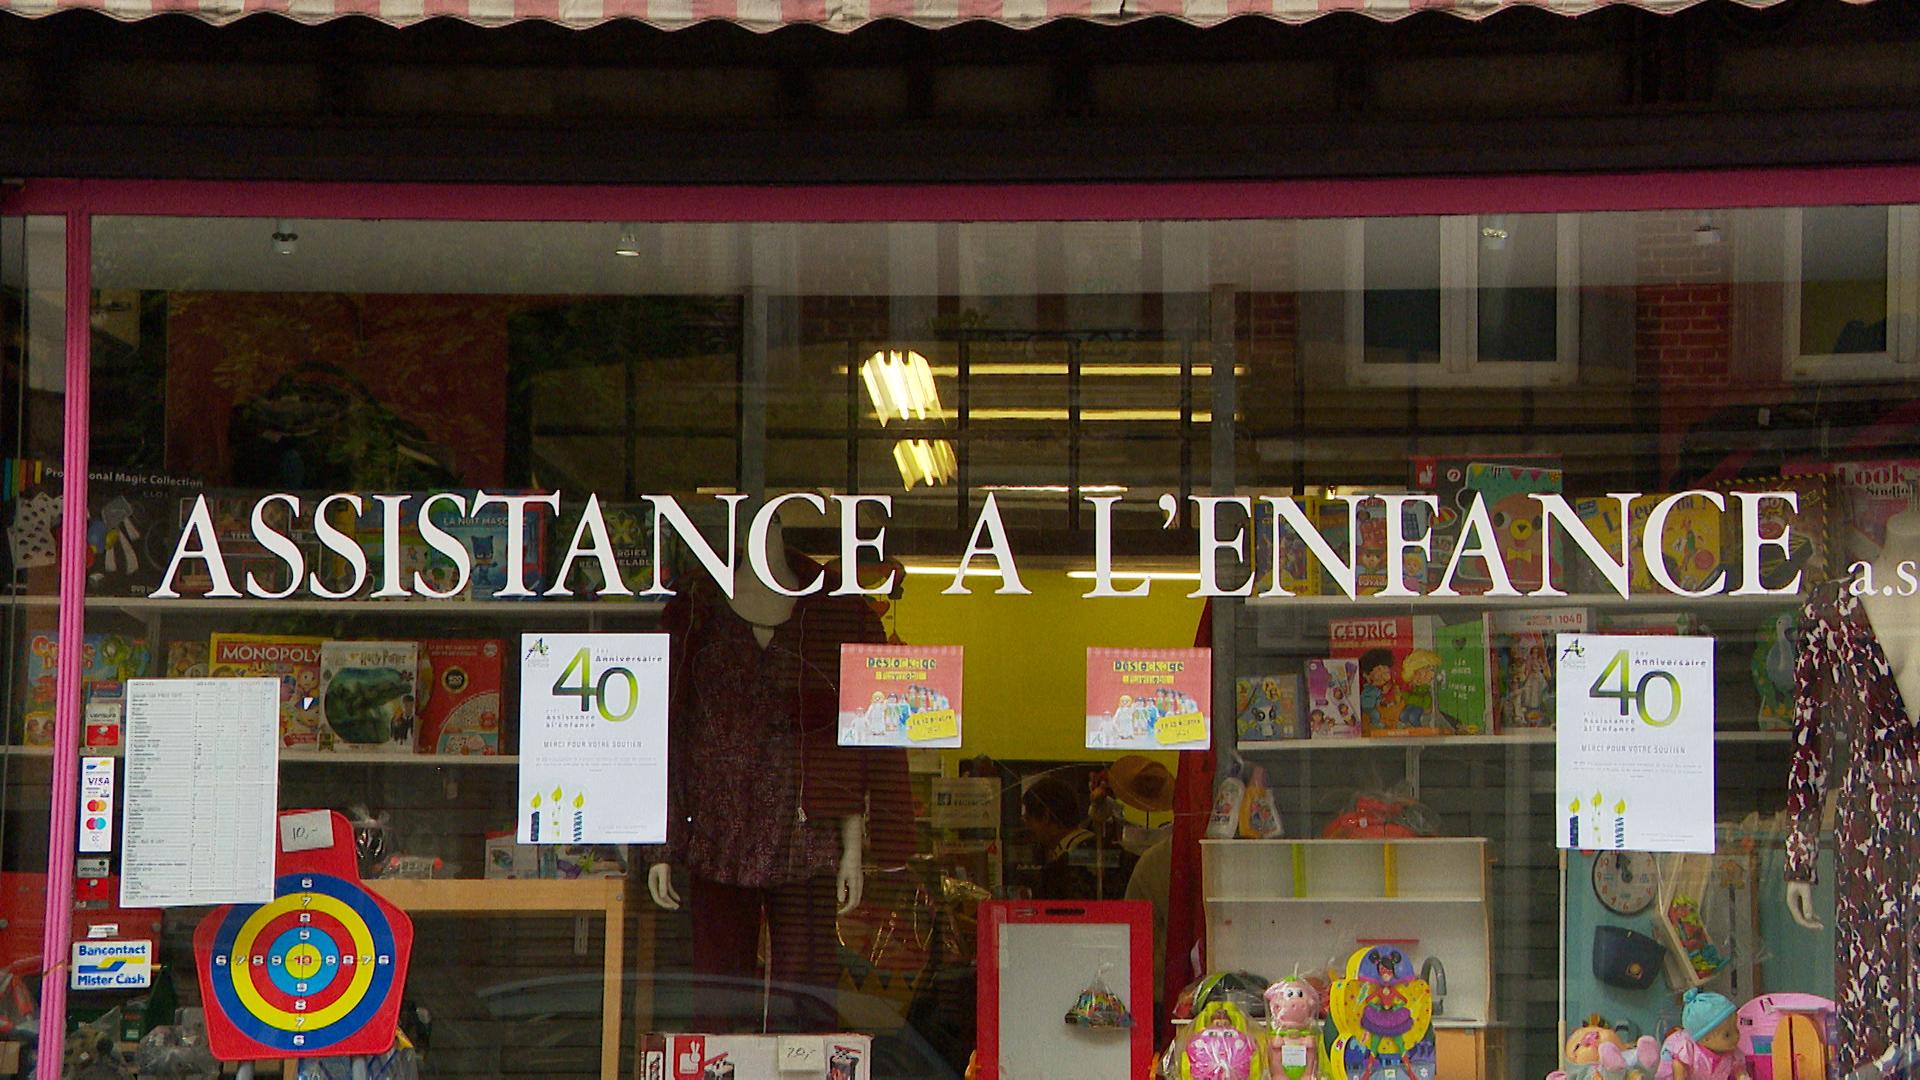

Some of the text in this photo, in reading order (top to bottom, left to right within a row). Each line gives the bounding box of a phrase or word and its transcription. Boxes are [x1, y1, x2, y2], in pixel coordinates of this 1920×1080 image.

[46, 468, 203, 487] Proonal Magic Collection
[149, 489, 896, 600] ASSISTANCE
[942, 492, 1032, 596] A
[1082, 490, 1802, 602] L'ENFANCE
[222, 646, 321, 662] MONOPOLY
[1634, 658, 1707, 667] Anniversaire
[552, 647, 639, 723] 40
[1589, 649, 1682, 728] 40
[87, 777, 110, 786] VISA
[79, 945, 146, 956] Bancontact
[77, 973, 145, 986] Mister Cash
